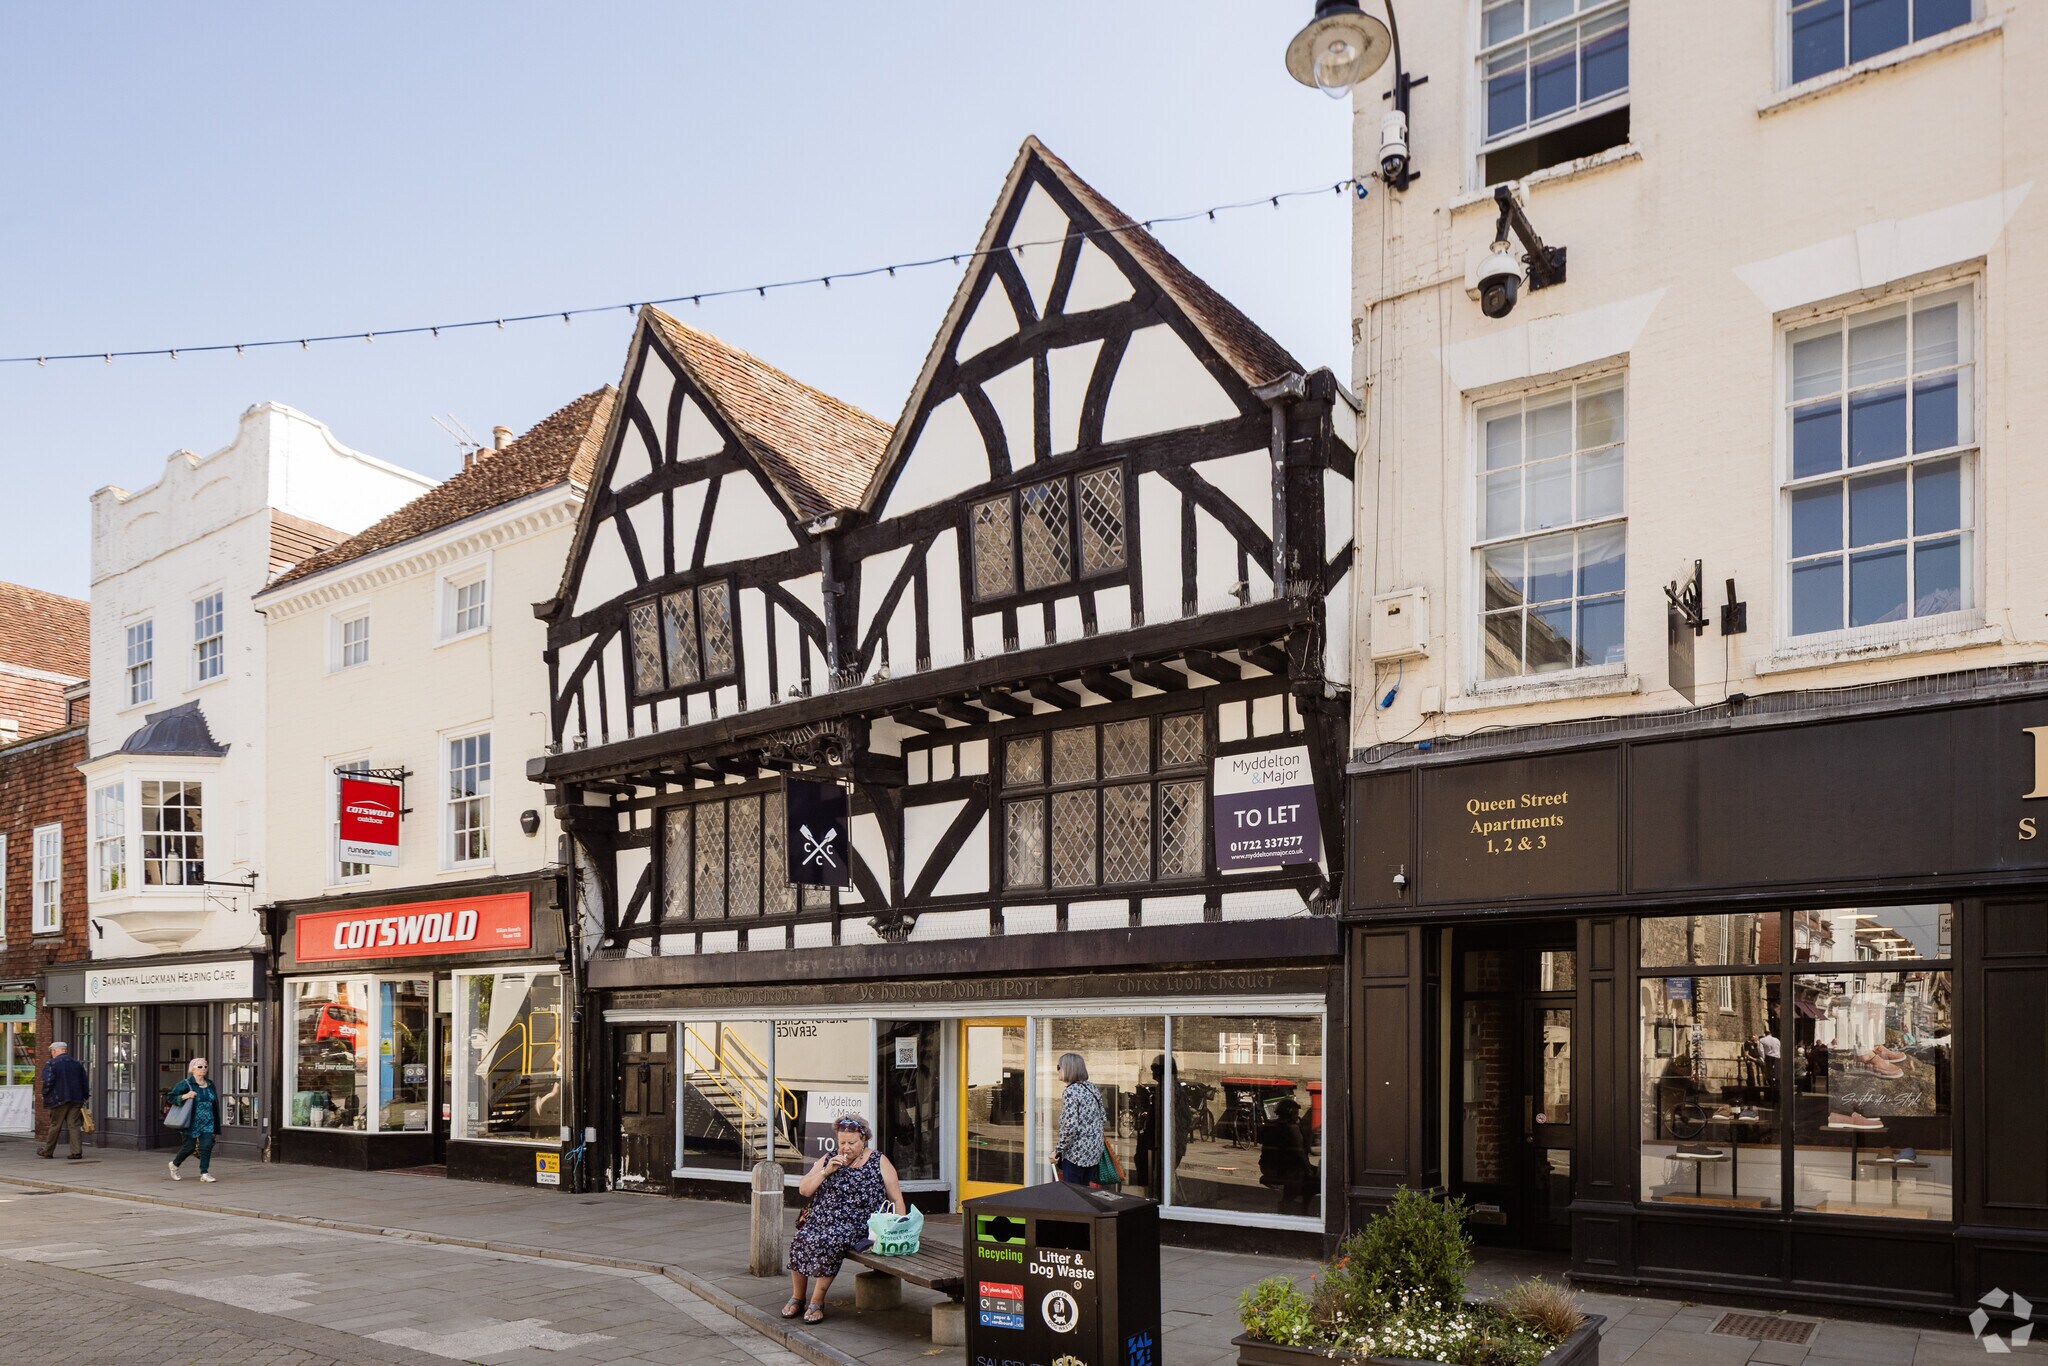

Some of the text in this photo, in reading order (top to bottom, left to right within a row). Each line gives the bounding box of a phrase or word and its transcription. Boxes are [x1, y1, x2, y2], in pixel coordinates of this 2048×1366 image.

[1233, 755, 1300, 774] Myddelton
[1466, 791, 1568, 815] Queen Street
[346, 806, 394, 817] COTSWOLD
[1234, 804, 1300, 828] TO LET
[1470, 814, 1564, 836] Apartments
[348, 847, 392, 856] runnersneed
[1231, 836, 1302, 851] 01722 337577
[1487, 835, 1546, 855] 1, 2 & 3
[1231, 848, 1303, 860] www.myddeltonmajor.co.uk
[333, 910, 478, 950] COTSWOLD
[102, 970, 235, 987] SAMANTHA LUCKMAN HEARING CARE
[930, 983, 943, 997] of
[818, 1096, 861, 1109] Myddelton
[817, 1137, 836, 1151] TO
[978, 1247, 1023, 1263] Recycling
[1040, 1251, 1083, 1265] Litter &
[1030, 1263, 1095, 1279] Dog Waste
